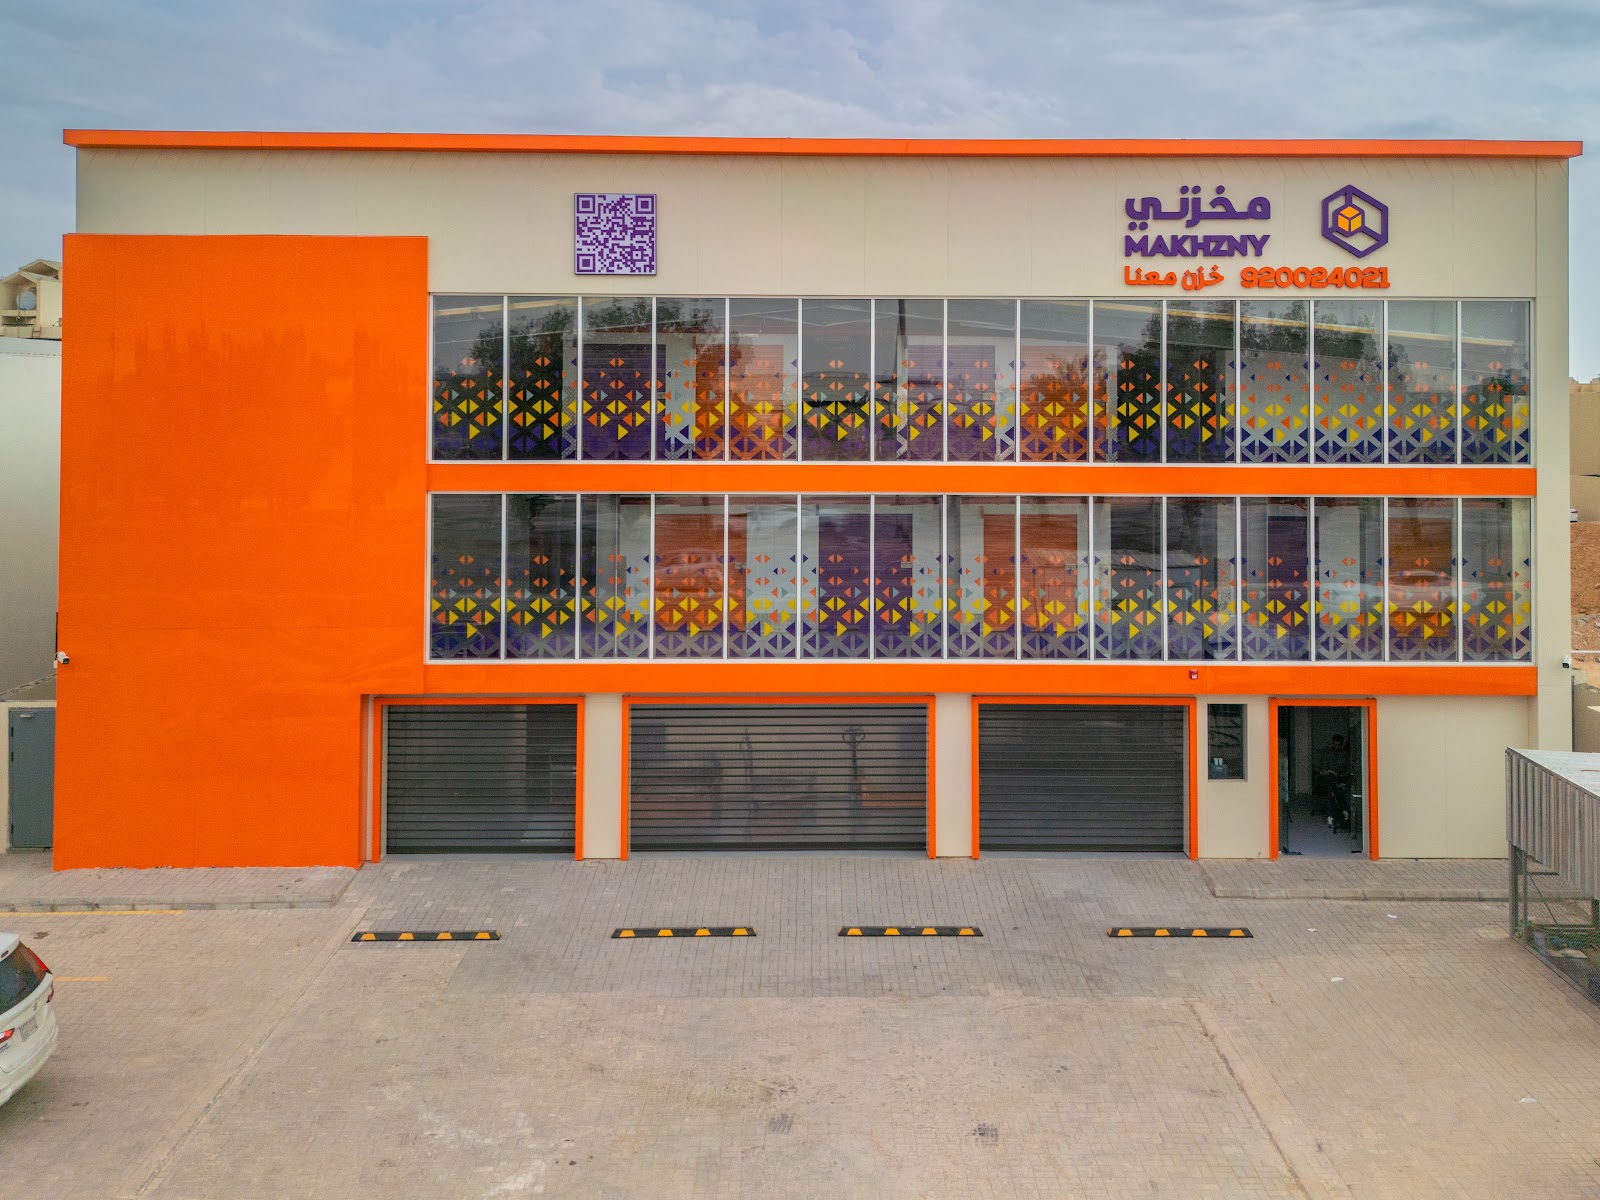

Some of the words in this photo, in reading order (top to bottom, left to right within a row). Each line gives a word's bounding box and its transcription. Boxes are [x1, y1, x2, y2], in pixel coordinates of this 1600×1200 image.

[1125, 185, 1271, 231] مخزني
[1125, 234, 1271, 257] MAKHZNY
[1124, 265, 1177, 286] معنا
[1181, 264, 1225, 291] خزن
[1240, 266, 1390, 288] 920024021
